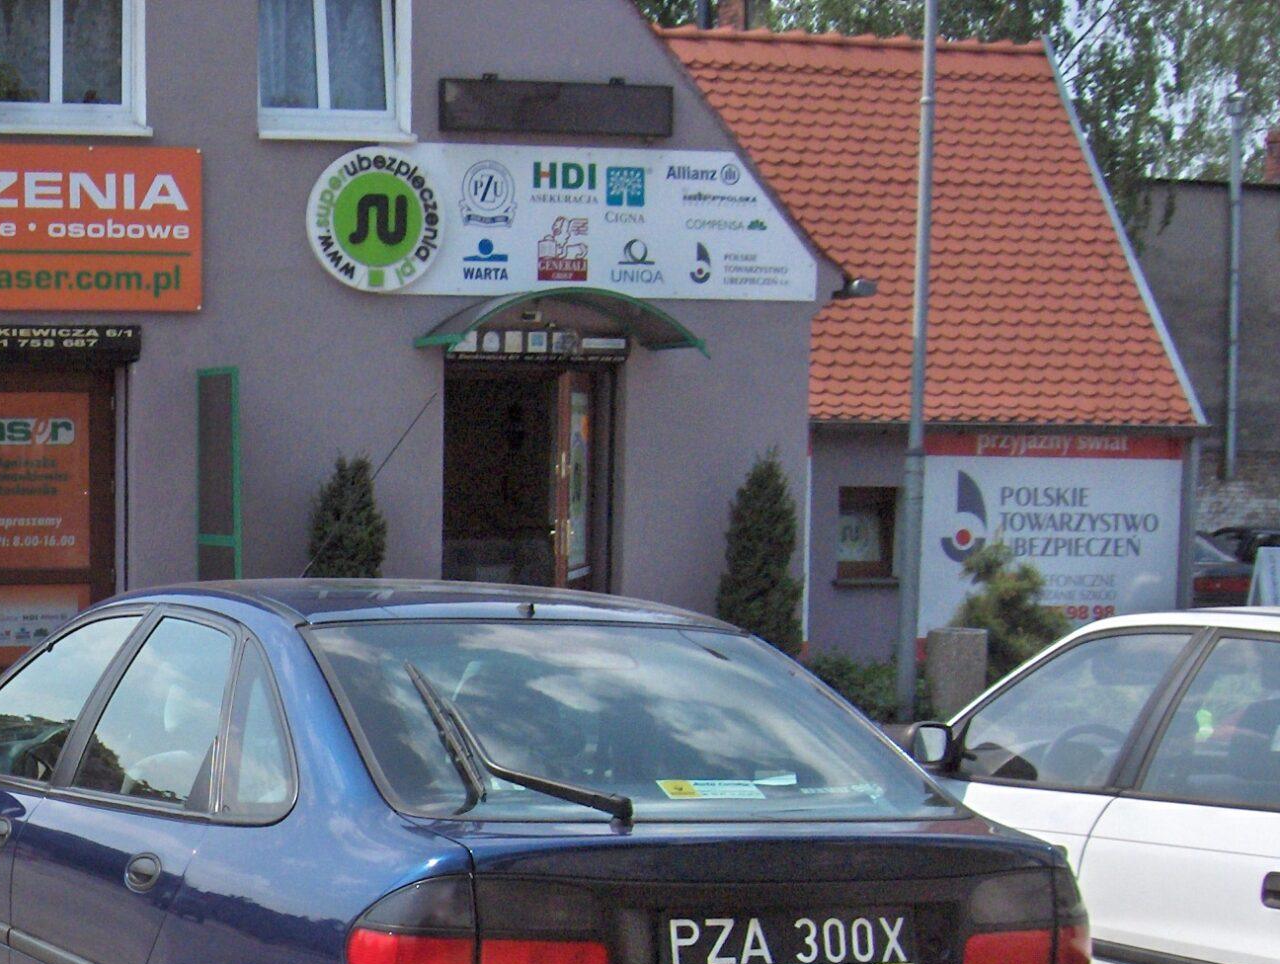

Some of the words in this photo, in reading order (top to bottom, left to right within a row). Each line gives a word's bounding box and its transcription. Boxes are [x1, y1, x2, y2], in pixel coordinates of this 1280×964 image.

[533, 162, 596, 190] HDI
[666, 165, 717, 180] Allianz
[47, 218, 190, 240] osobowe
[685, 218, 744, 230] COMPENSA
[463, 267, 508, 280] WARTA
[610, 269, 665, 284] UNIQA
[106, 329, 132, 338] 6/1
[18, 338, 55, 348] 758
[63, 338, 98, 348] 687
[999, 486, 1090, 507] POLSKIE
[999, 512, 1159, 533] TOWARZYSTWO
[794, 917, 908, 964] 300X
